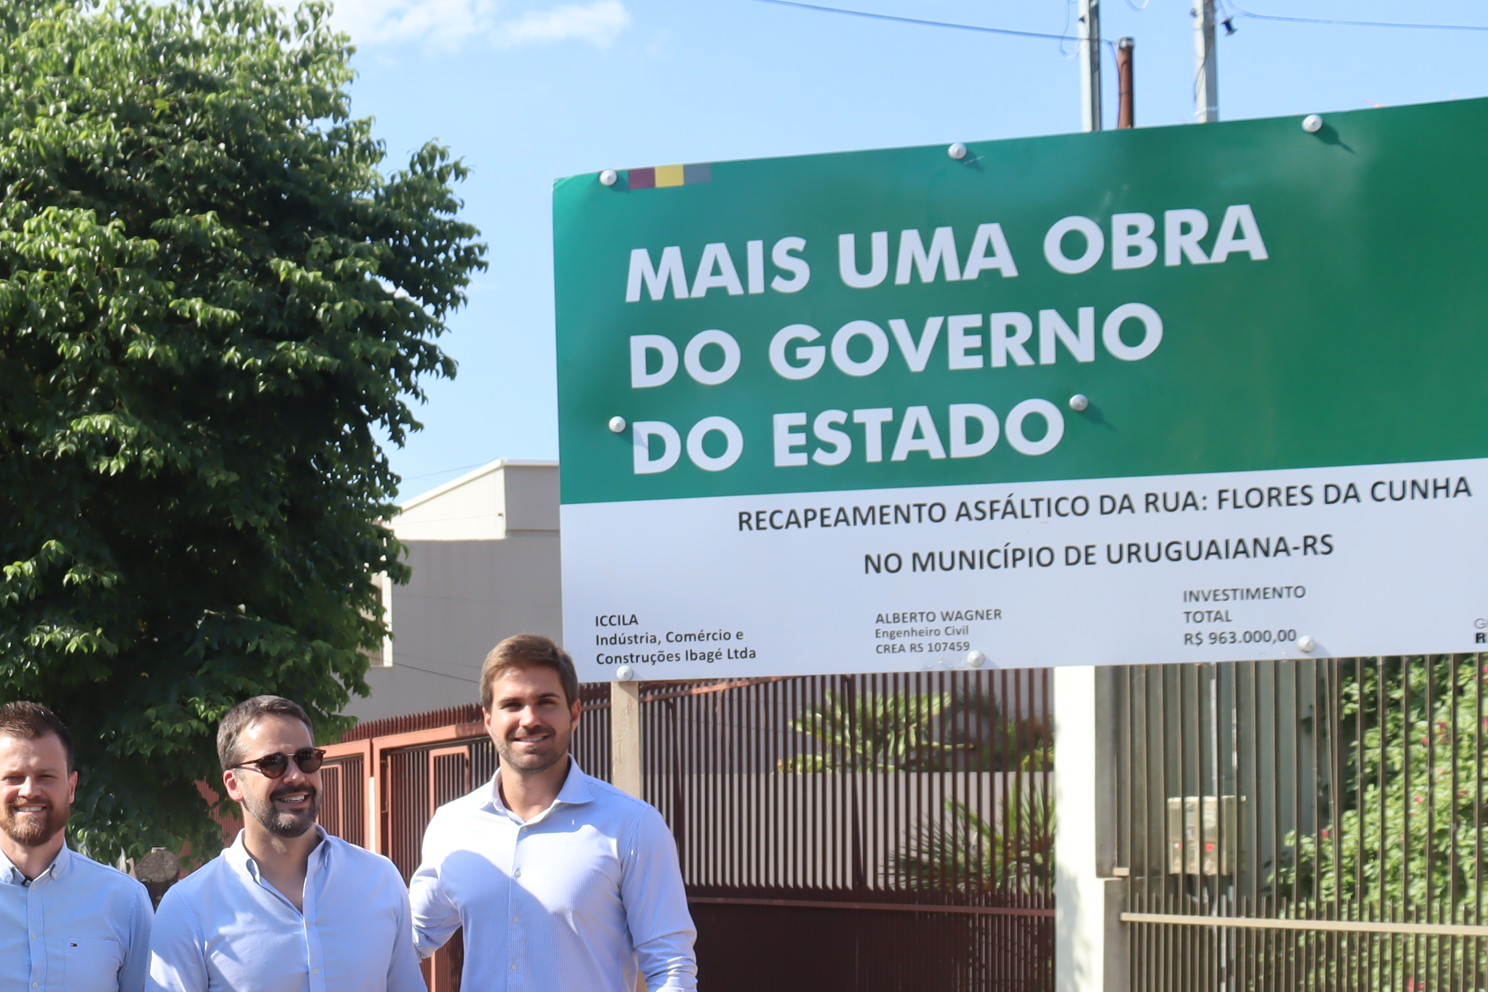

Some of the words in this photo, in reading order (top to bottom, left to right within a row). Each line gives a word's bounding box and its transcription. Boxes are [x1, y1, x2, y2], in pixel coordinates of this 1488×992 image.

[625, 236, 812, 303] MAIS
[838, 223, 1019, 290] UMA
[1044, 204, 1269, 274] OBRA
[630, 329, 742, 389] DO
[768, 302, 1164, 380] GOVERNO
[632, 416, 744, 476] DO
[773, 398, 1065, 467] ESTADO
[737, 501, 947, 532] RECAPEAMENTO
[955, 493, 1090, 522] ASFÁLTICO
[1098, 493, 1136, 516] DA
[1144, 490, 1209, 514] RUA:
[1217, 484, 1313, 511] FLORES
[1323, 482, 1361, 505] DA
[1370, 475, 1473, 502] CUNHA
[864, 552, 903, 575] NO
[911, 542, 1055, 573] MUNICÍPIO
[1064, 544, 1097, 566] DE
[1106, 533, 1334, 565] URUGUAIANA-RS
[1183, 585, 1307, 603] INVESTIMENTO
[595, 613, 639, 627] ICCILA
[875, 611, 937, 624] ALBERTO
[940, 609, 1003, 622] WAGNER
[1183, 610, 1233, 624] TOTAL
[595, 632, 662, 646] Indústria,
[665, 629, 732, 643] Comércio
[735, 630, 745, 641] e
[875, 626, 941, 640] Engenheiro
[944, 625, 970, 636] Civil
[1184, 631, 1204, 647] R$
[1208, 629, 1298, 645] 963.000,00
[596, 650, 681, 666] Construções
[684, 648, 723, 664] Ibagé
[727, 647, 757, 660] Ltda
[875, 643, 907, 654] CREA
[909, 642, 924, 653] RS
[927, 641, 970, 652] 107459
